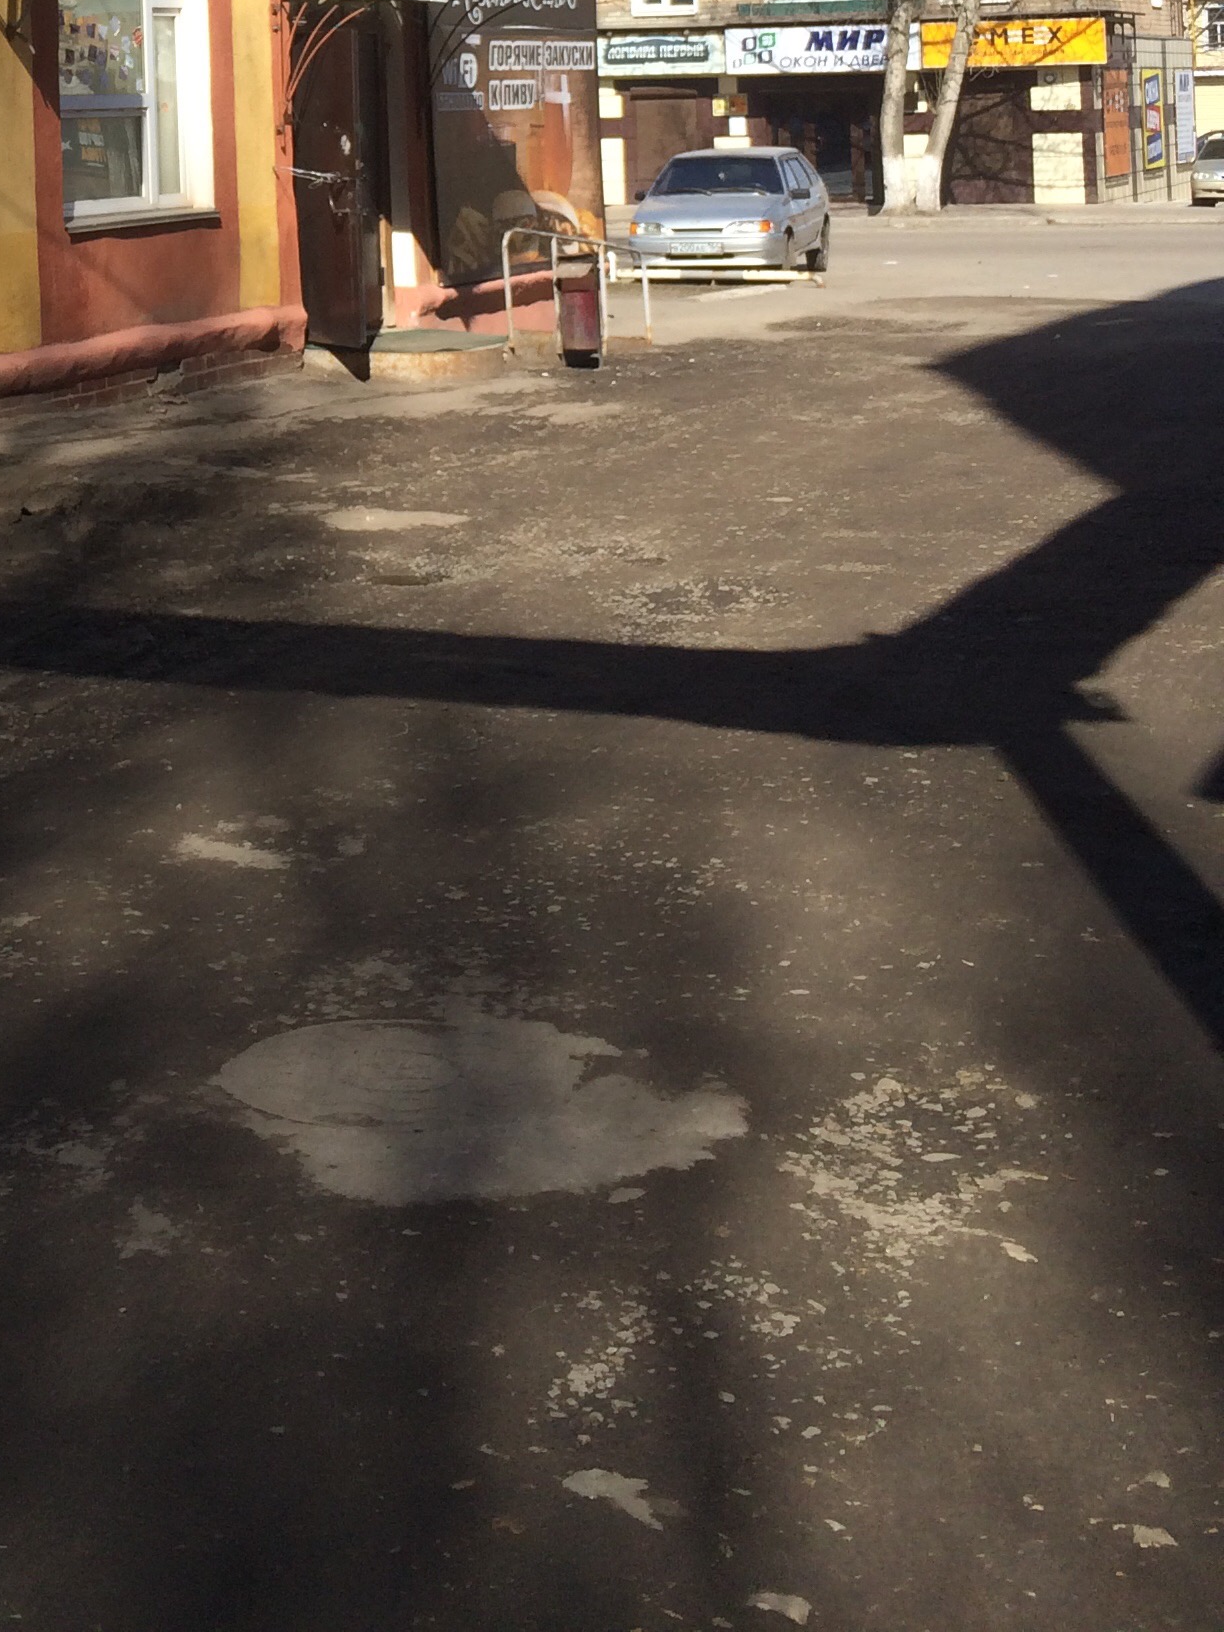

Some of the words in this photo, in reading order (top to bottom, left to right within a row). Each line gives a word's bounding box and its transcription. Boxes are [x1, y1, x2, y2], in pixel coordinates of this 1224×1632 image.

[804, 28, 886, 52] МИР
[490, 42, 543, 69] ГОРЯЧИЕ
[544, 42, 594, 69] ЗАКУСКИ
[779, 55, 826, 68] ОКОН
[833, 55, 845, 68] И
[849, 54, 890, 68] ДВЕР
[490, 82, 500, 108] К
[502, 81, 535, 108] ПИВУ
